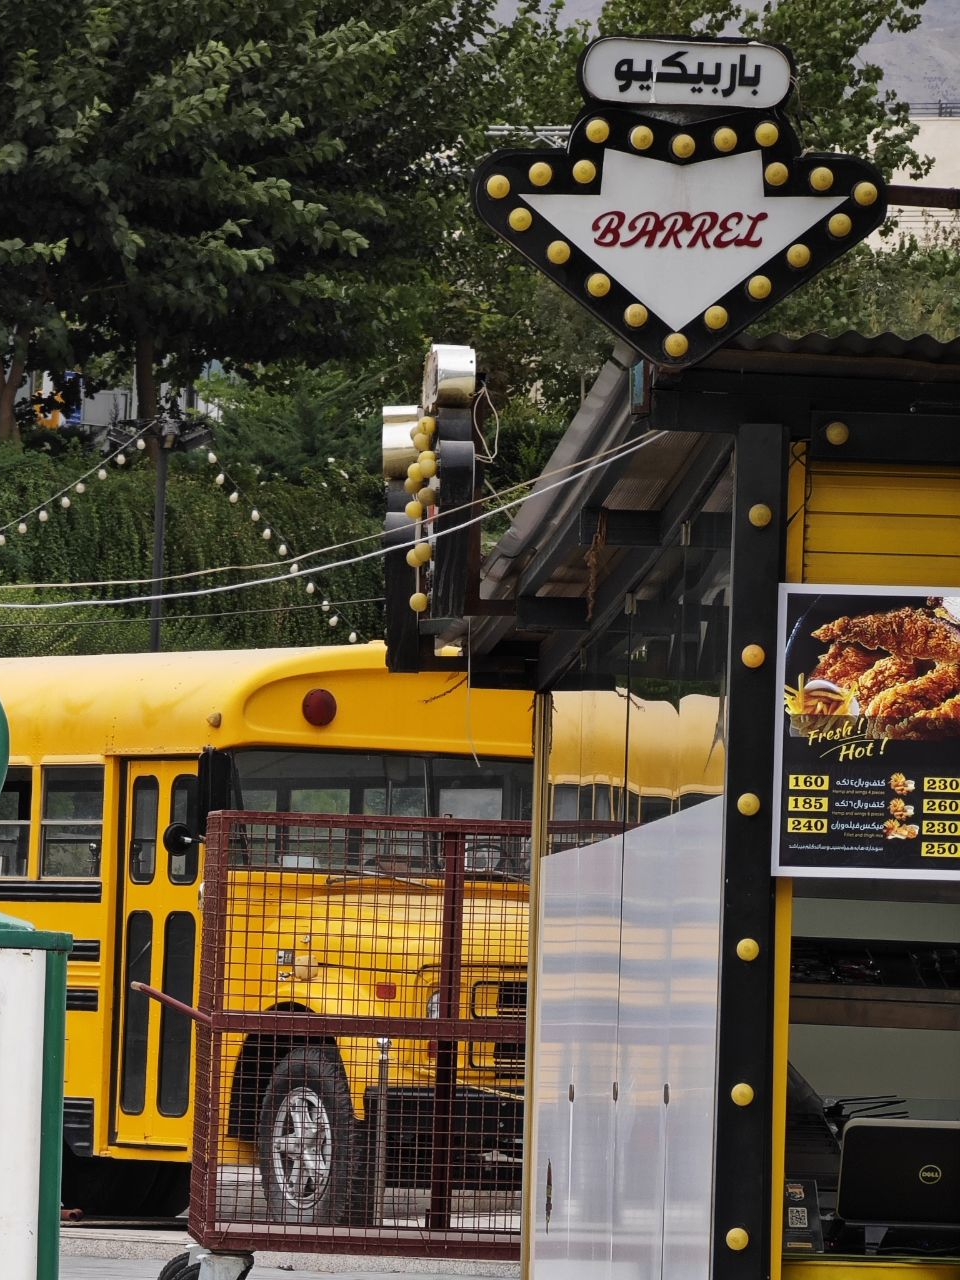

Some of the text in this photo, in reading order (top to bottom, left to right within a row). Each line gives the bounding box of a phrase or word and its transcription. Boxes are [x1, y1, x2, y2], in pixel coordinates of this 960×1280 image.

[613, 50, 762, 97] باربیکیو
[591, 210, 769, 250] BARREL
[792, 775, 825, 788] 160
[926, 778, 960, 791] 230
[792, 797, 824, 810] 185
[926, 800, 959, 812] 260
[791, 819, 825, 832] 240
[925, 821, 959, 834] 230
[925, 843, 959, 855] 250
